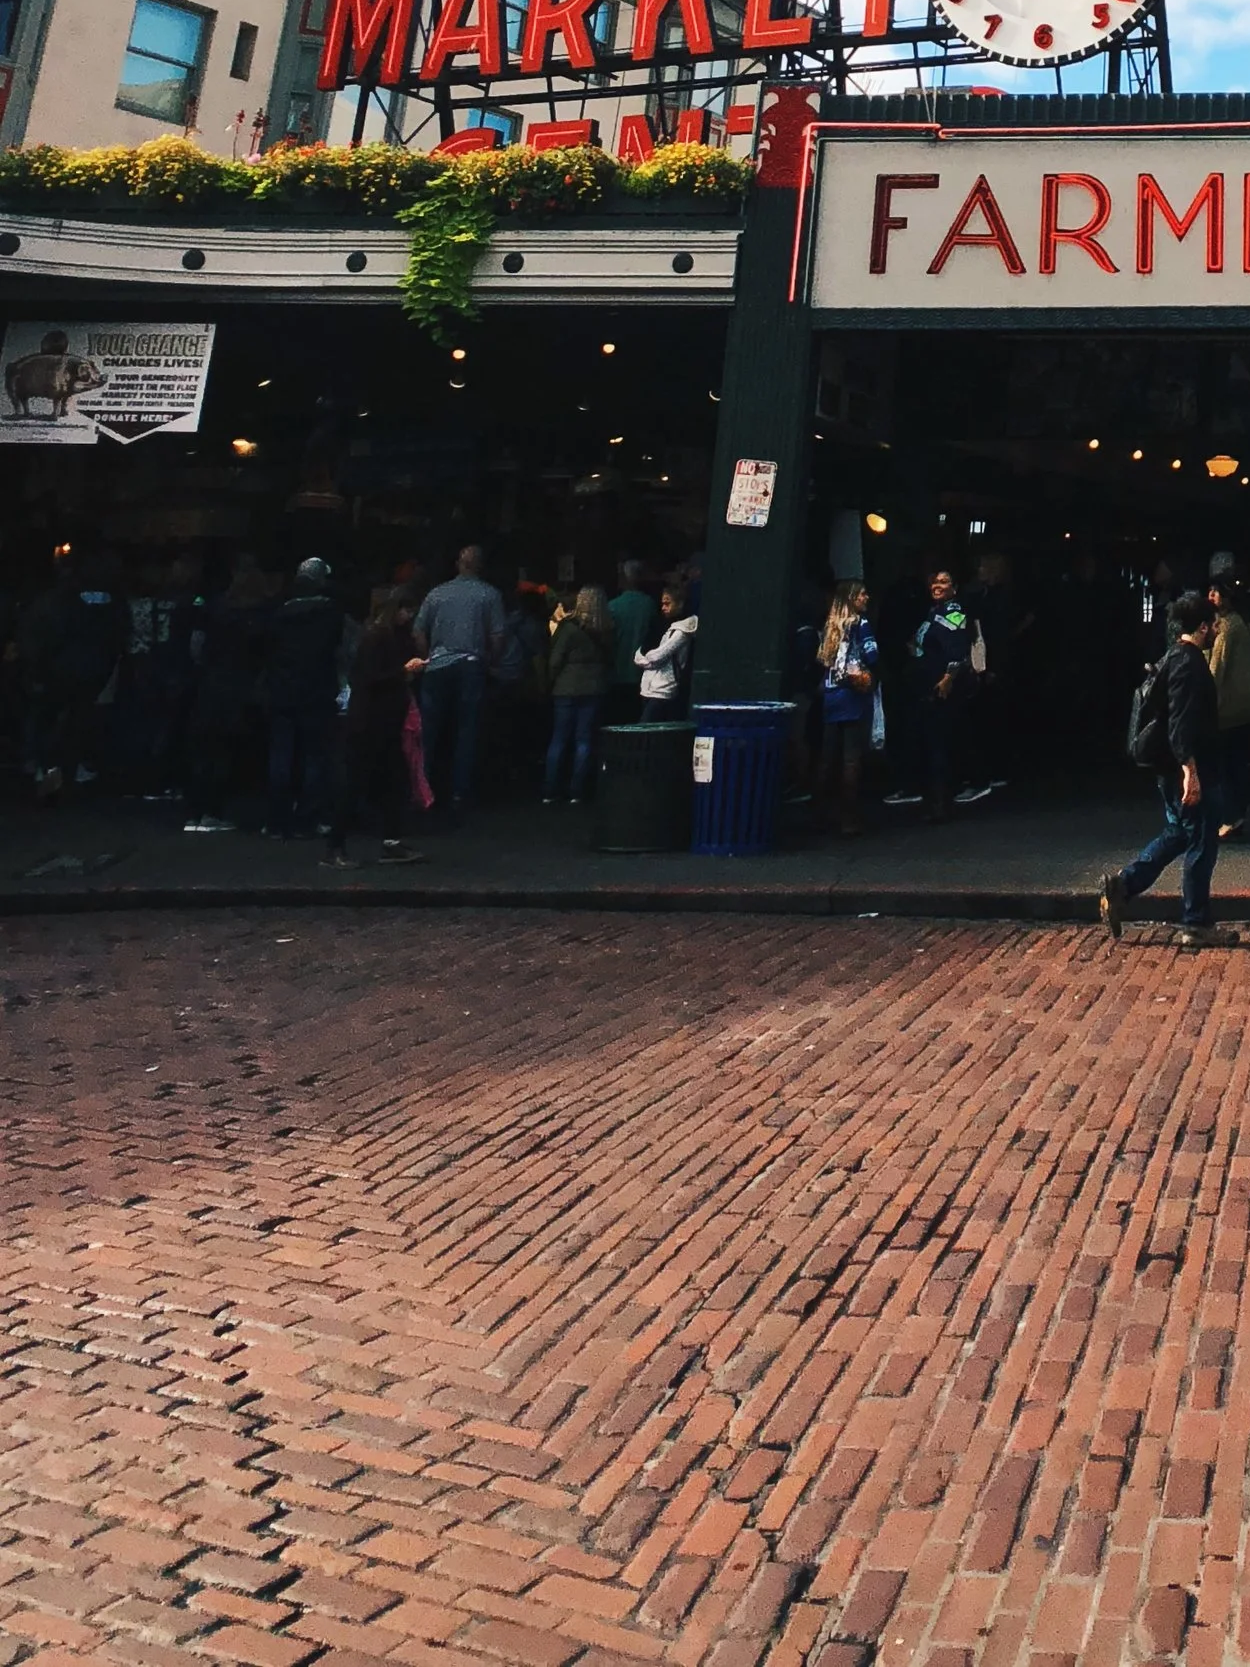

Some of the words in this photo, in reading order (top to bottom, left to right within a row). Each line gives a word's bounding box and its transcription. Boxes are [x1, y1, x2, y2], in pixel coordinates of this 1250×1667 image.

[983, 14, 1003, 40] 7
[1091, 3, 1110, 29] 5
[1034, 24, 1053, 49] 6
[87, 334, 134, 356] YOUR
[134, 334, 209, 357] CHANGE
[103, 358, 161, 367] CHANGES
[94, 414, 138, 422] DONATE
[741, 461, 756, 474] NO
